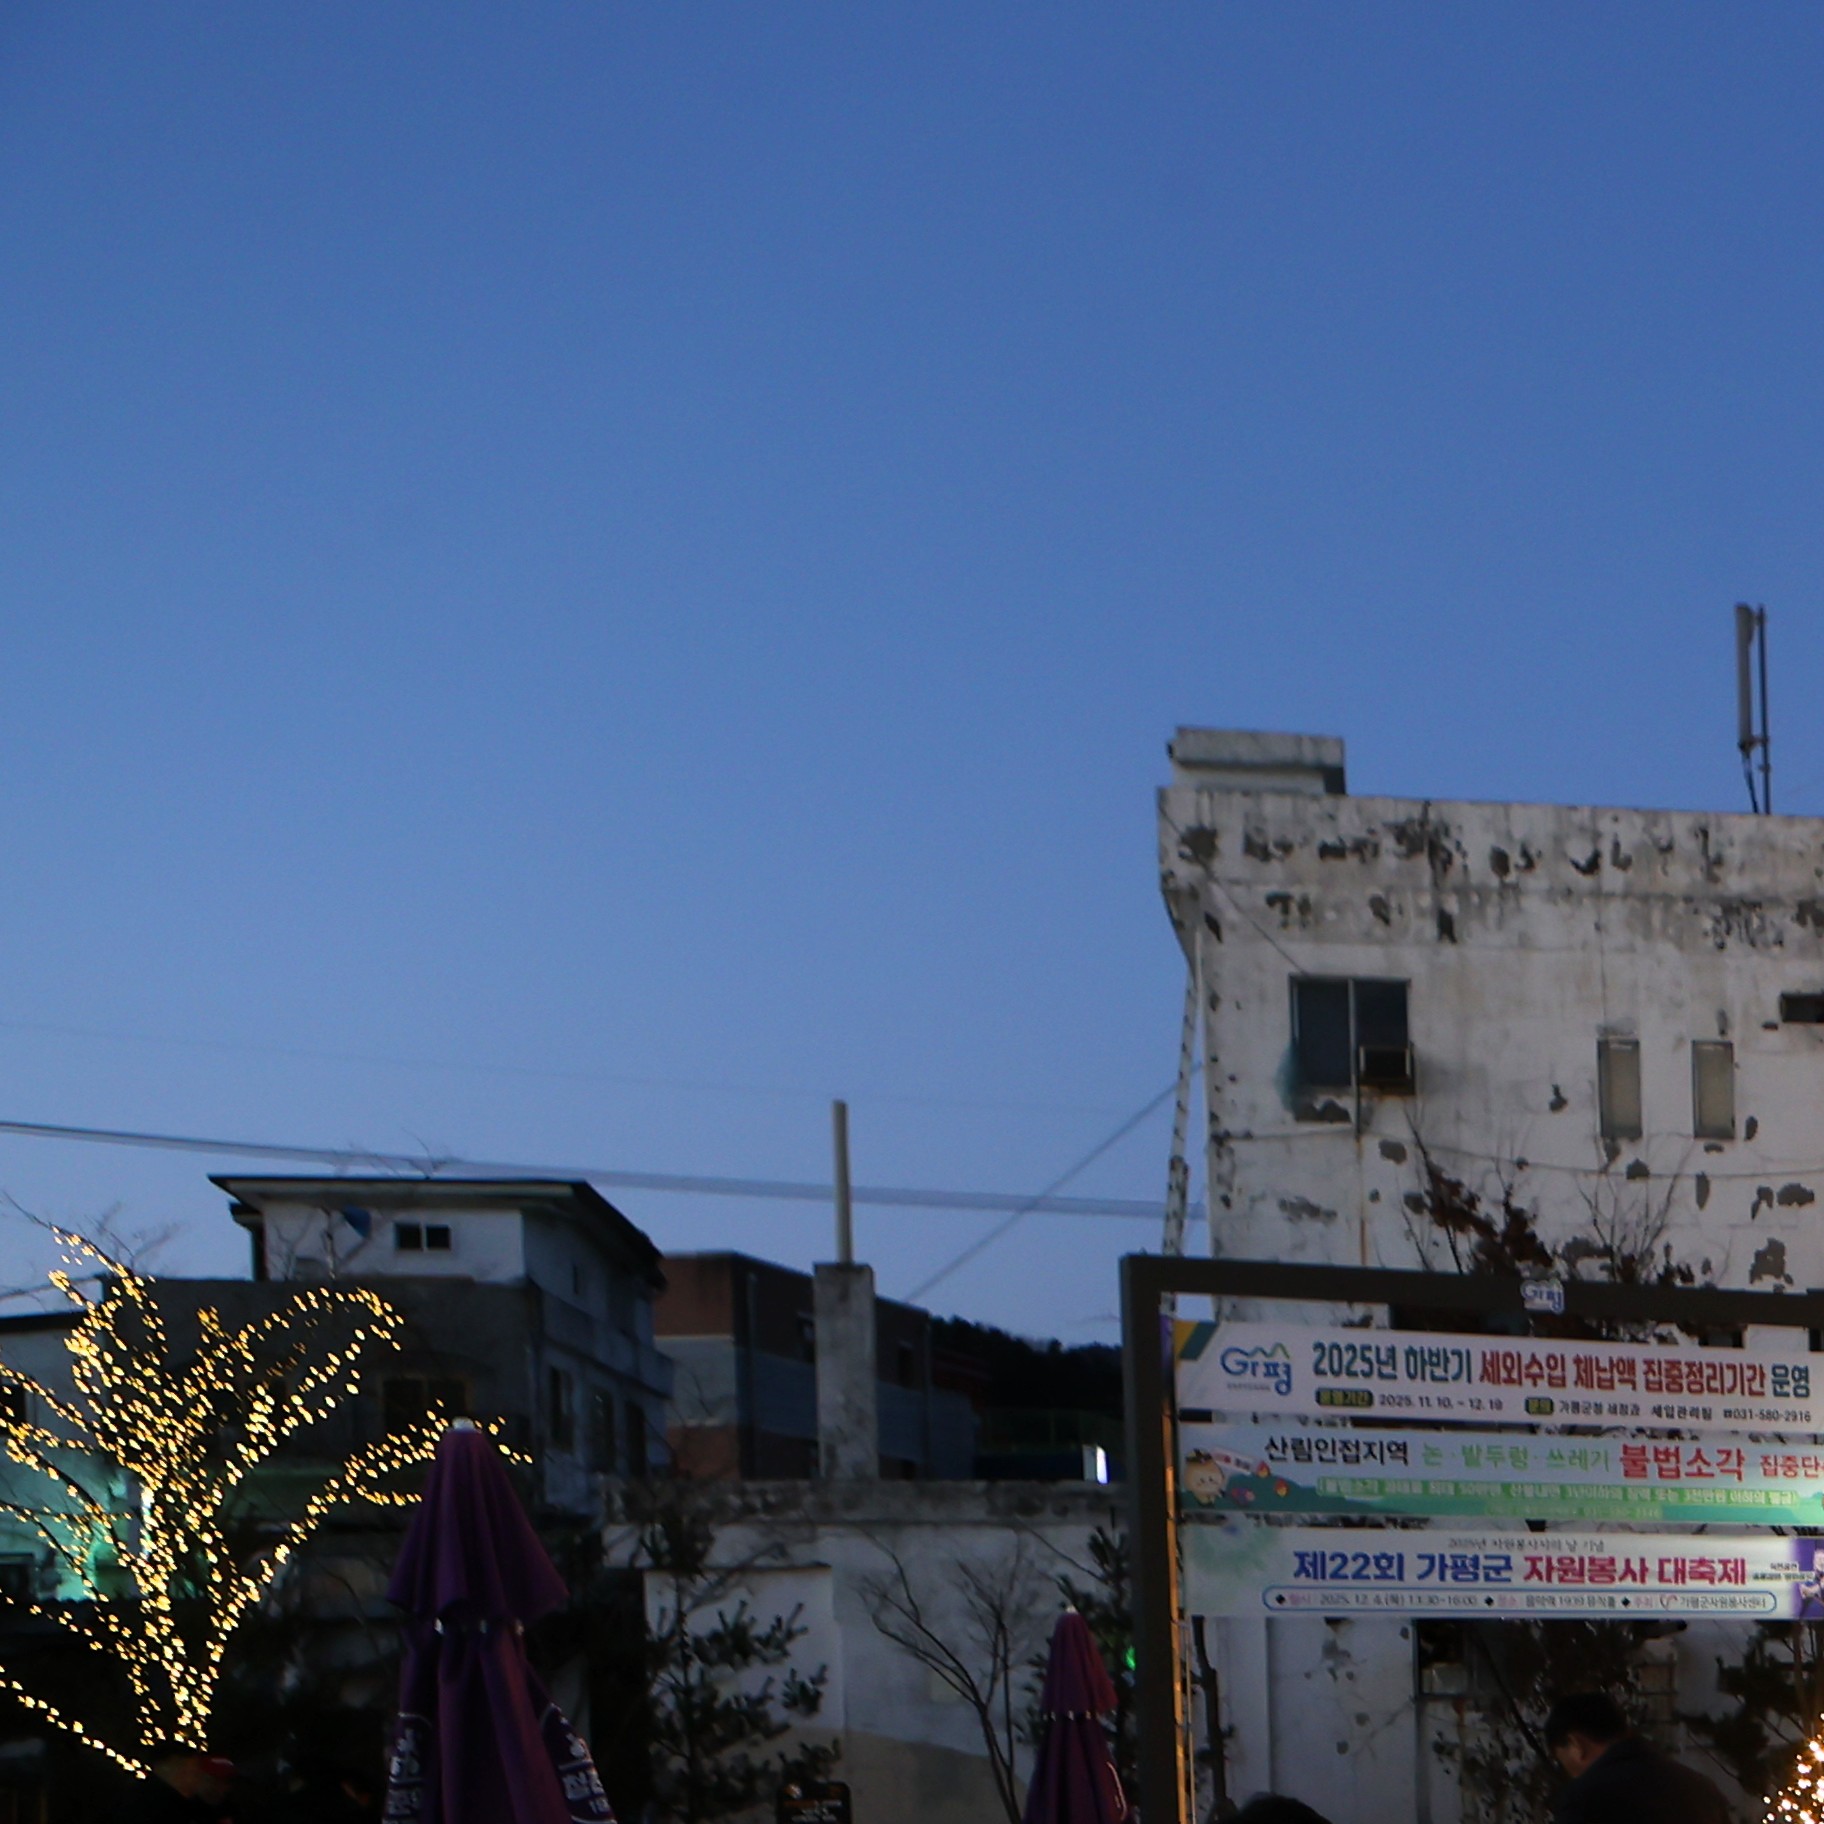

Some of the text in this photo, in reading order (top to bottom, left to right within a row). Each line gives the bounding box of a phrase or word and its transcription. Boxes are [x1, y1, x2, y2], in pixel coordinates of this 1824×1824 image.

[1312, 1340, 1811, 1399] 2025년 하반기 세외수입 체납액 집중정리기간 운영
[1264, 1435, 1409, 1466] 산림인접지역
[1549, 1446, 1610, 1473] 쓰레기
[1618, 1442, 1746, 1482] 불법소각
[1293, 1551, 1746, 1586] 제22회 가평군 자원봉사 대축제
